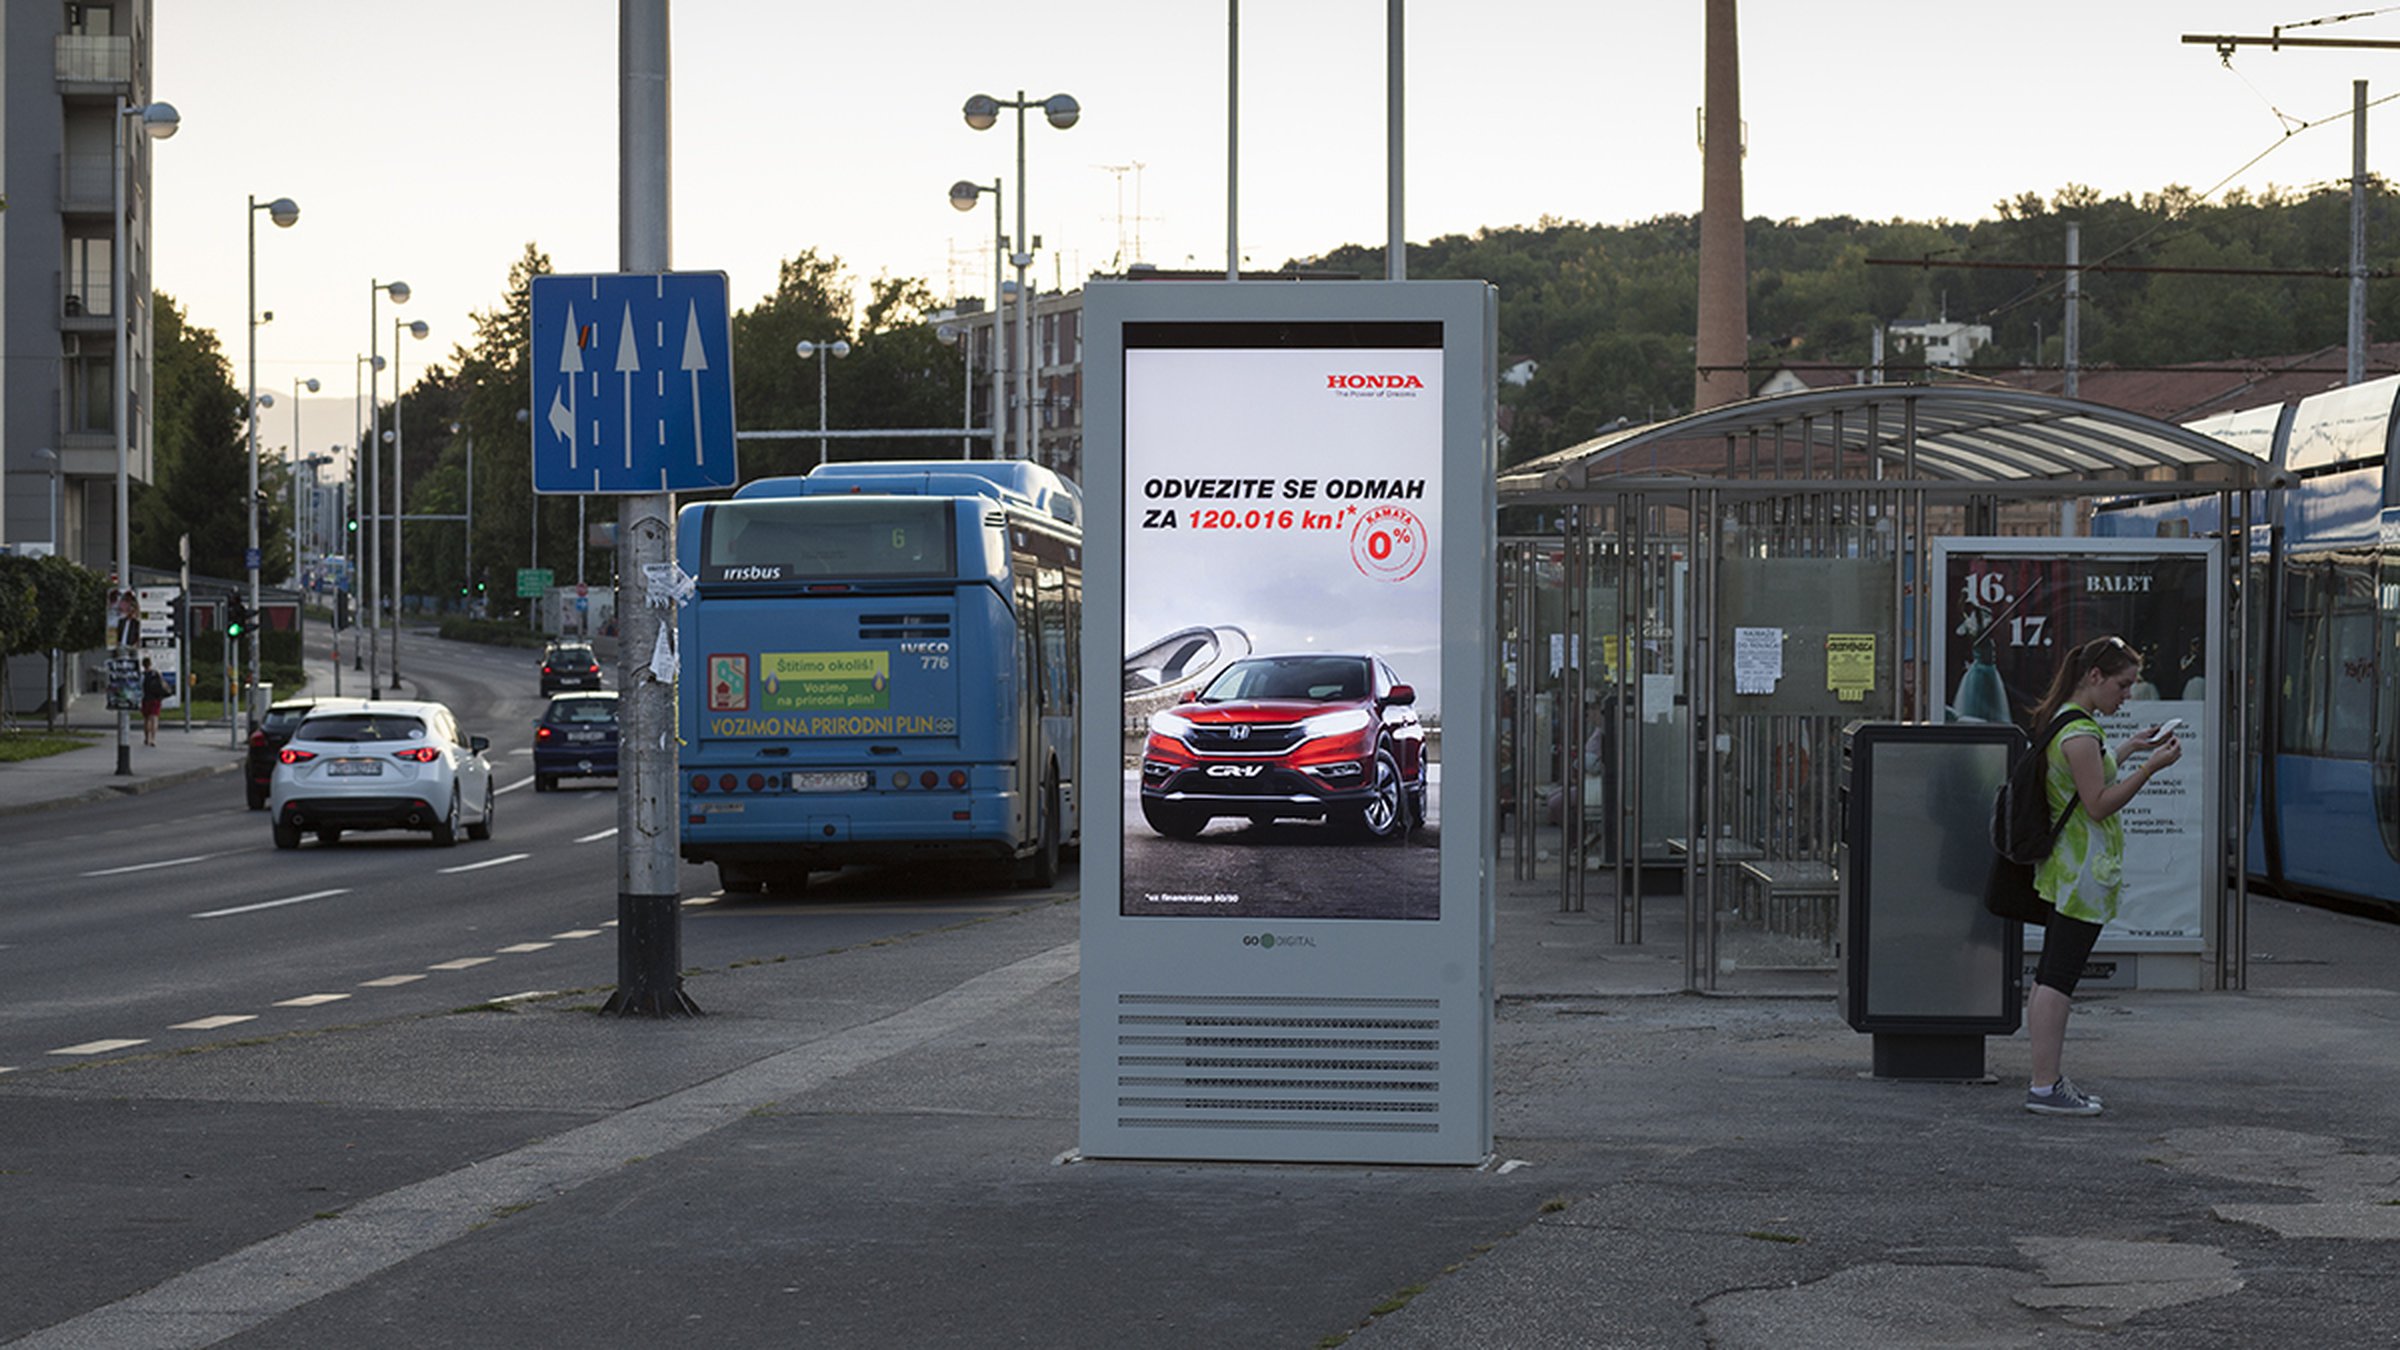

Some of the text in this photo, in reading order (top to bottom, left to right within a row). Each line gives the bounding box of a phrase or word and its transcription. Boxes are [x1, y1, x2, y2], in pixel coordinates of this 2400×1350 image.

[1327, 374, 1425, 388] HONDA
[1144, 479, 1426, 499] ODVEZITE SE ODMAH
[1142, 509, 1177, 529] ZA
[1188, 509, 1294, 529] 120.016
[1365, 507, 1412, 525] KAMATA
[891, 527, 905, 549] 6
[1367, 527, 1412, 560] 0%
[723, 566, 782, 580] irisbus
[1963, 572, 2153, 604] 16. BALET
[2008, 615, 2054, 648] 17.
[900, 642, 950, 654] IVECO
[777, 656, 875, 673] Štitimo okoliš!
[920, 656, 950, 670] 776
[803, 682, 849, 694] Vozimo
[777, 693, 875, 708] na prirodni plin!
[710, 715, 934, 736] VOZIMO NA PRIRODNI PLIN
[1205, 765, 1264, 777] CR-V
[1243, 935, 1317, 947] GO DIGITAL
